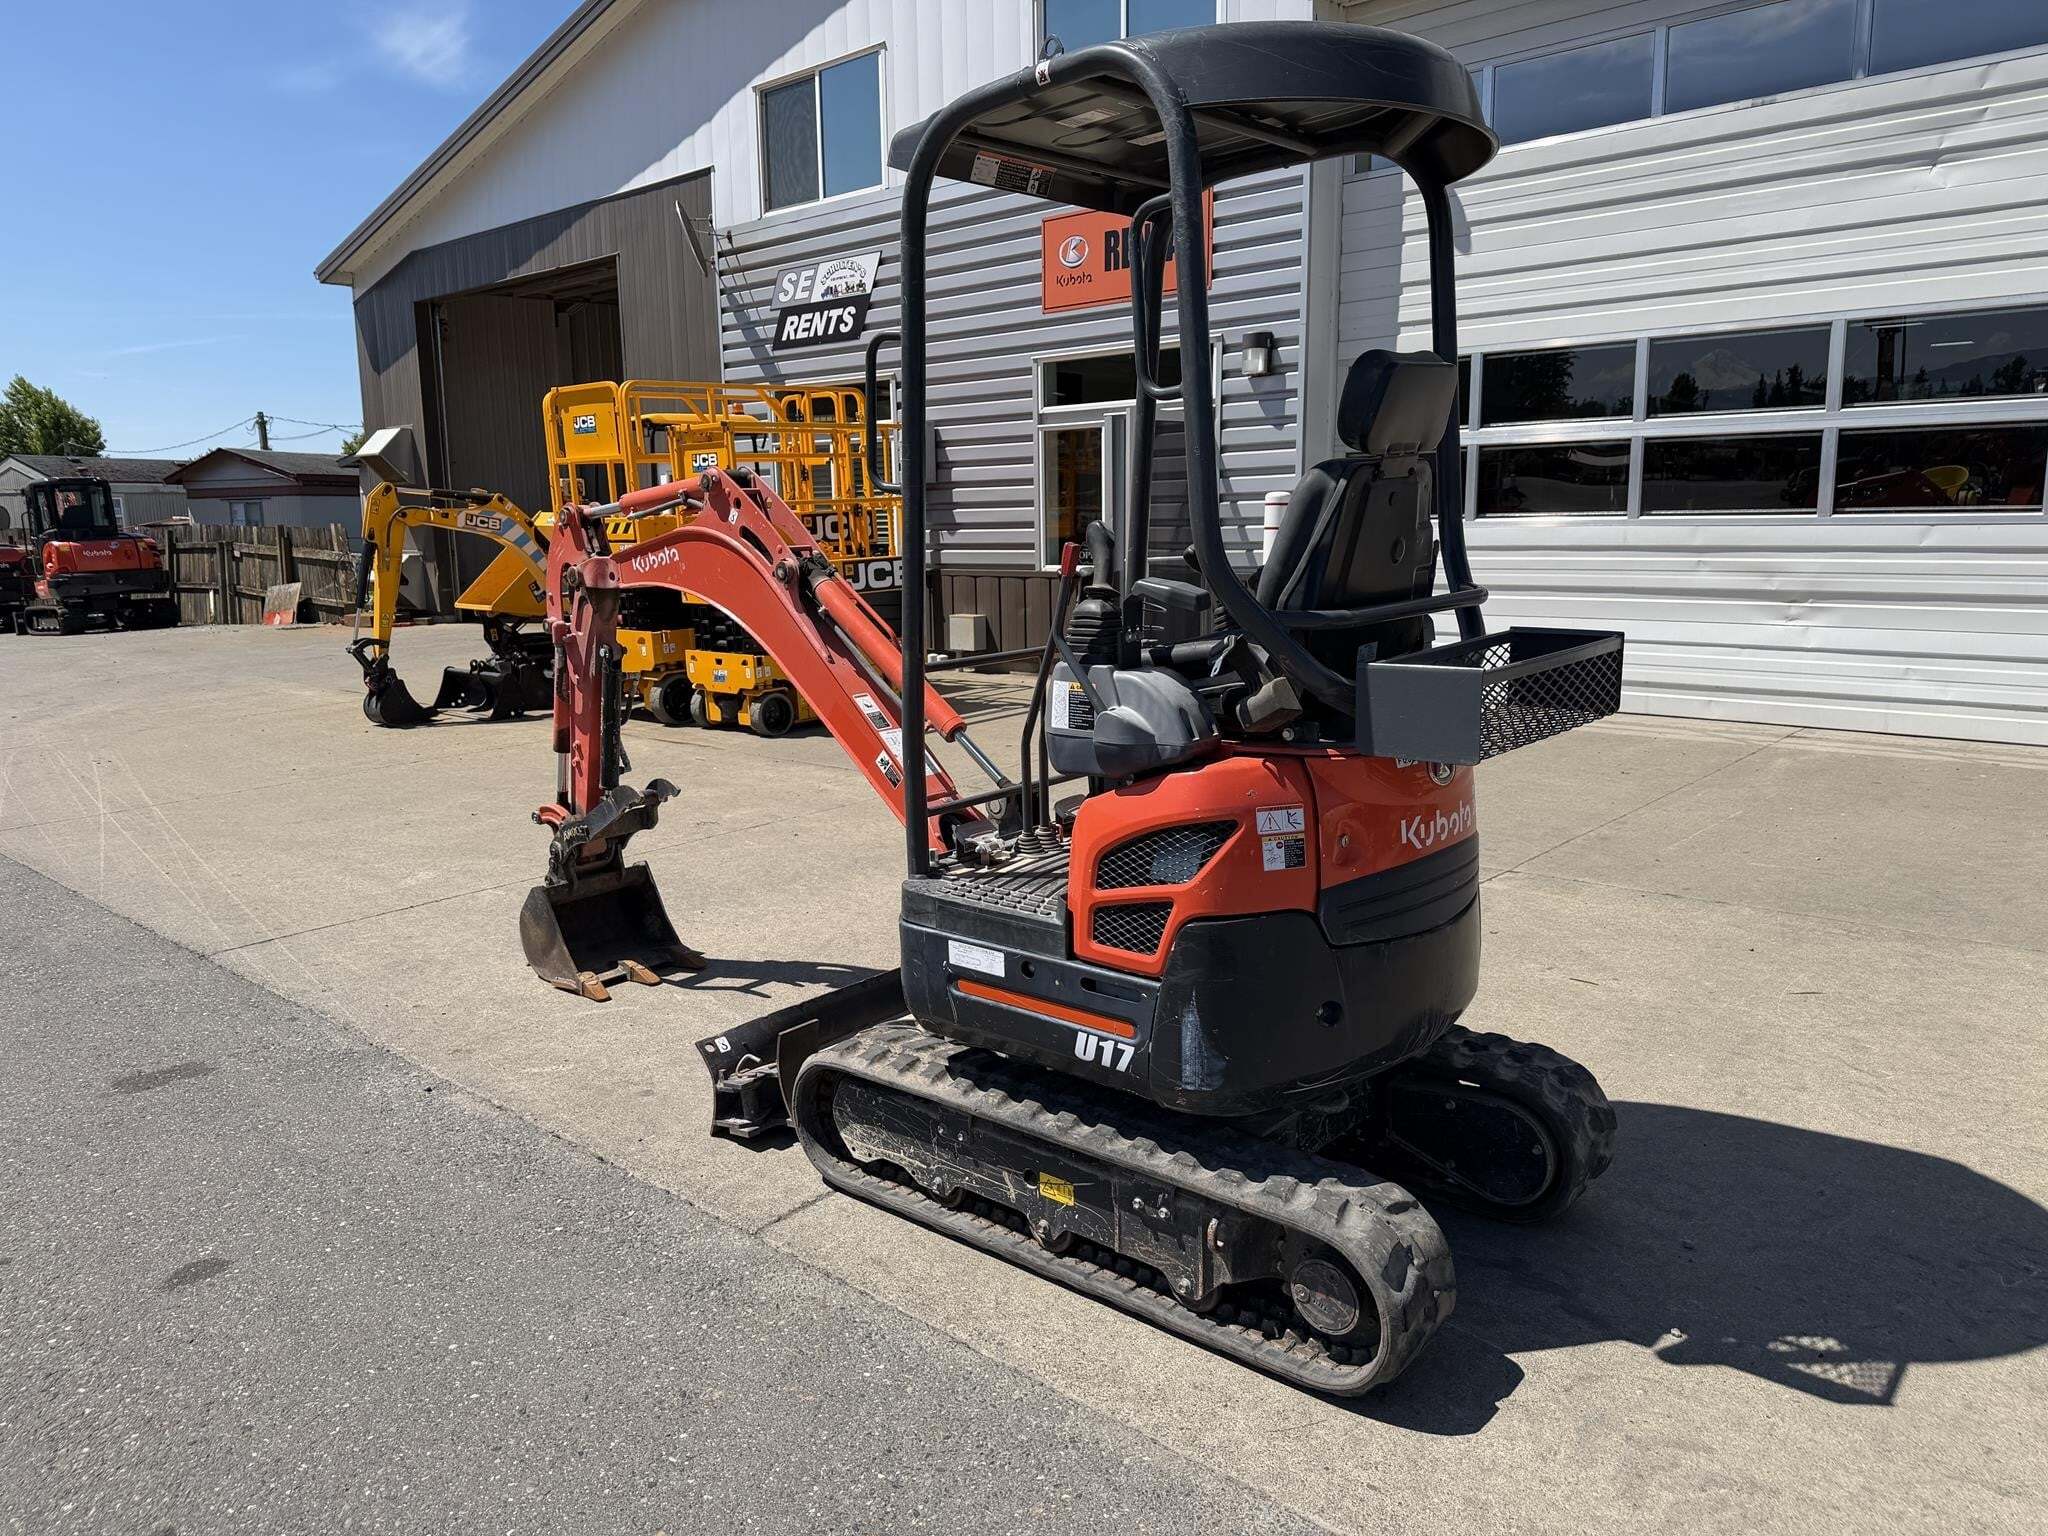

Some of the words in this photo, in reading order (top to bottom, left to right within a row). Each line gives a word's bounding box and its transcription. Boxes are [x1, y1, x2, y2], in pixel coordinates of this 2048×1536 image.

[779, 269, 815, 302] SE
[1056, 271, 1093, 288] Kubota
[781, 306, 856, 341] RENTS
[574, 415, 596, 429] JCB
[692, 453, 718, 467] JCB
[466, 513, 501, 530] JCB
[809, 514, 872, 540] JC
[83, 549, 112, 557] Kubota
[632, 546, 680, 573] Kubota
[1401, 800, 1472, 849] Kubota
[1074, 1031, 1136, 1073] U17
